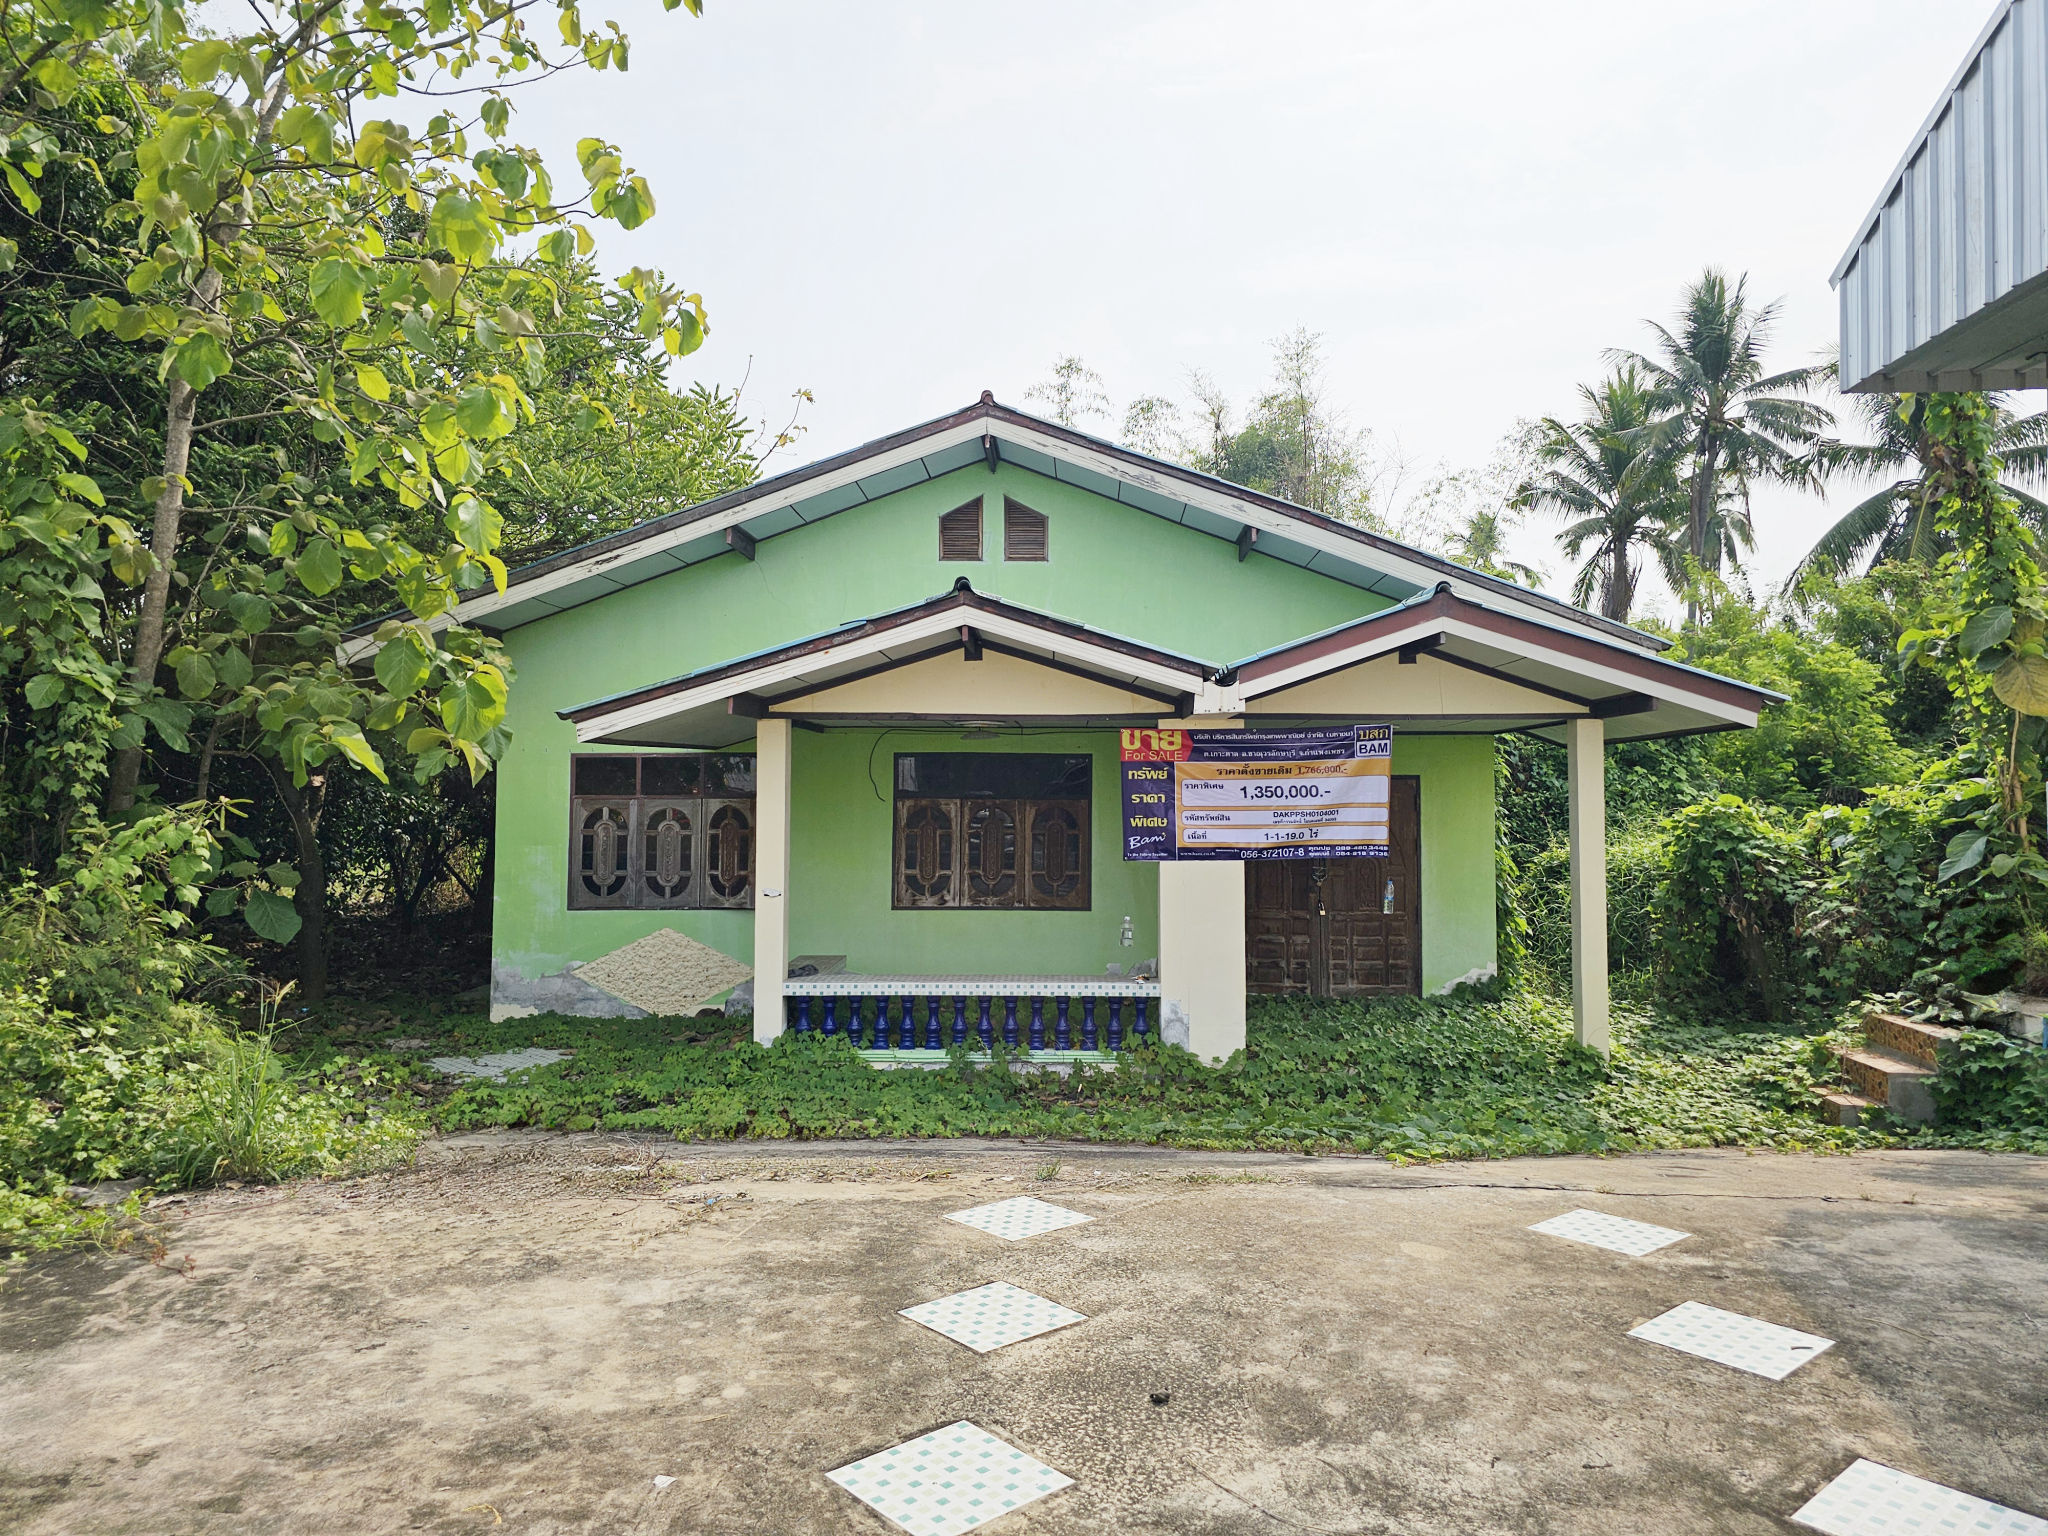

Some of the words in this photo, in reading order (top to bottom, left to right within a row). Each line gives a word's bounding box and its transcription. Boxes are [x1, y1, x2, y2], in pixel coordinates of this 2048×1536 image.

[1121, 729, 1182, 751] ขาย
[1326, 730, 1354, 738] (มหาชน)
[1358, 728, 1389, 740] บสก
[1359, 742, 1388, 754] BAM
[1125, 750, 1146, 761] For
[1149, 750, 1183, 761] SALE
[1128, 766, 1168, 780] ทรัพย์
[1184, 781, 1224, 790] ราคาพิเศษ
[1131, 793, 1166, 804] ราคา
[1240, 784, 1331, 801] 1,350,000.-
[1130, 815, 1168, 828] พิเศษ
[1184, 813, 1231, 822] รหัสทรัพย์สิน
[1187, 830, 1207, 840] เนื้อที่
[1264, 831, 1305, 841] 1-1-19.0
[1308, 828, 1319, 838] ไร่
[1240, 847, 1305, 859] 056-372107-8
